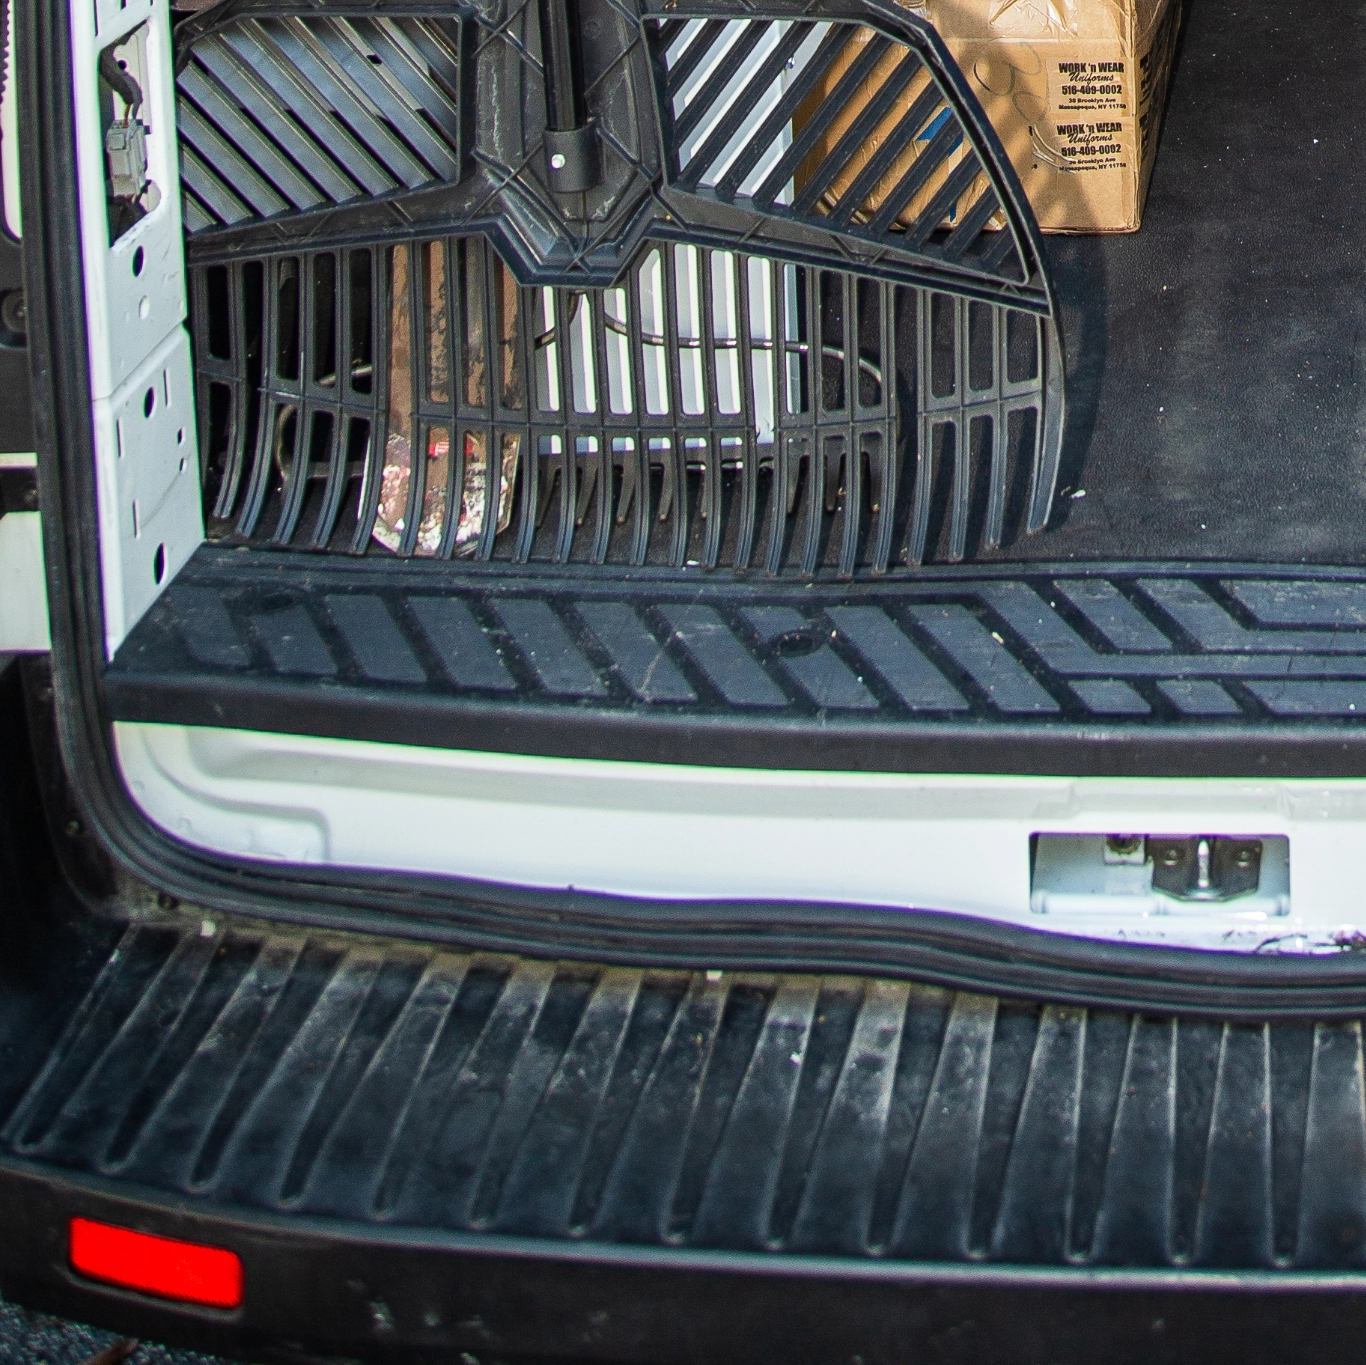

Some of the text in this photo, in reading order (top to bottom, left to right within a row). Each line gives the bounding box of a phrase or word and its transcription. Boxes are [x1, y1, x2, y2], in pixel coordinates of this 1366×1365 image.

[1058, 62, 1087, 73] WORK
[1098, 62, 1125, 73] WEAR
[1068, 71, 1114, 85] Uniforms
[1061, 84, 1122, 95] 516-409-0002
[1077, 97, 1104, 105] Brooklyn
[1056, 123, 1086, 135] WORK
[1096, 122, 1123, 133] WEAR
[1067, 132, 1113, 146] Uniforms
[1061, 143, 1122, 157] 516-409-0002
